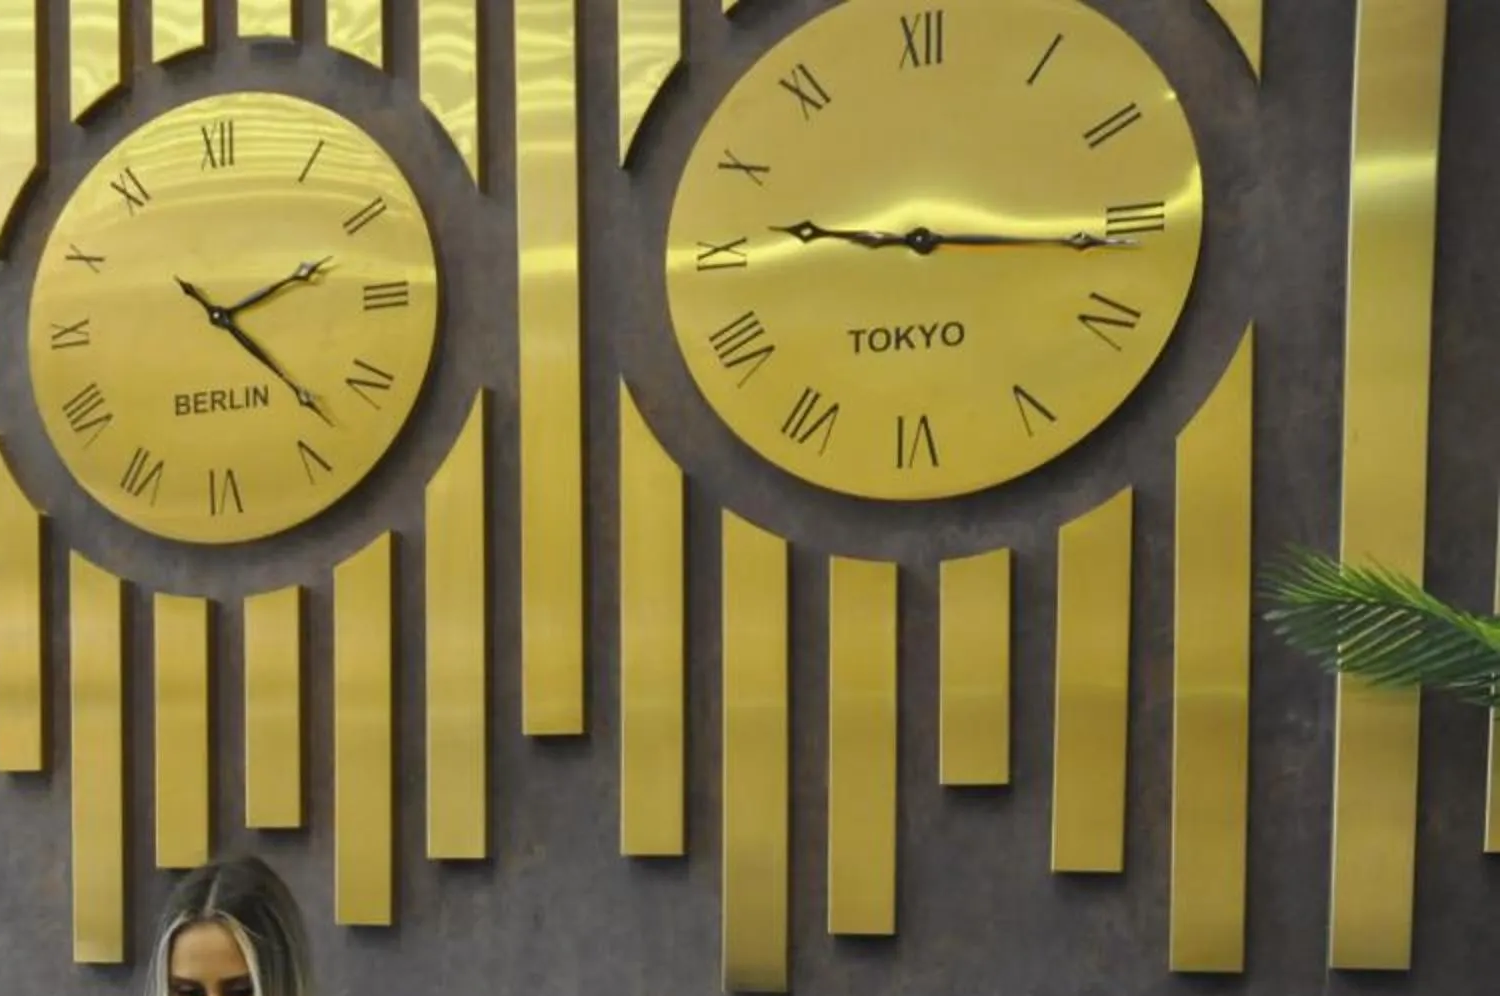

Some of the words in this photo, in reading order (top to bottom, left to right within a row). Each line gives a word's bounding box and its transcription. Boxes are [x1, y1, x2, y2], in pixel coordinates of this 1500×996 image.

[900, 10, 943, 69] XII
[1027, 33, 1063, 86] I
[779, 63, 831, 121] XI
[201, 120, 234, 170] XII
[1083, 103, 1141, 149] II
[299, 140, 324, 183] I
[718, 149, 770, 186] X
[110, 167, 151, 216] XI
[343, 197, 387, 235] II
[1106, 201, 1165, 236] III
[65, 244, 105, 273] X
[697, 237, 747, 271] IX
[363, 281, 408, 310] III
[51, 319, 90, 350] IX
[848, 322, 965, 355] TOKYO
[1078, 292, 1141, 352] IV
[709, 311, 776, 388] VIII
[175, 385, 269, 416] BERLIN
[345, 358, 394, 410] IV
[62, 383, 113, 450] VIII
[780, 387, 839, 457] VII
[1012, 385, 1057, 438] V
[297, 441, 332, 485] V
[897, 414, 939, 469] VI
[120, 447, 164, 508] VII
[209, 468, 243, 516] VI
